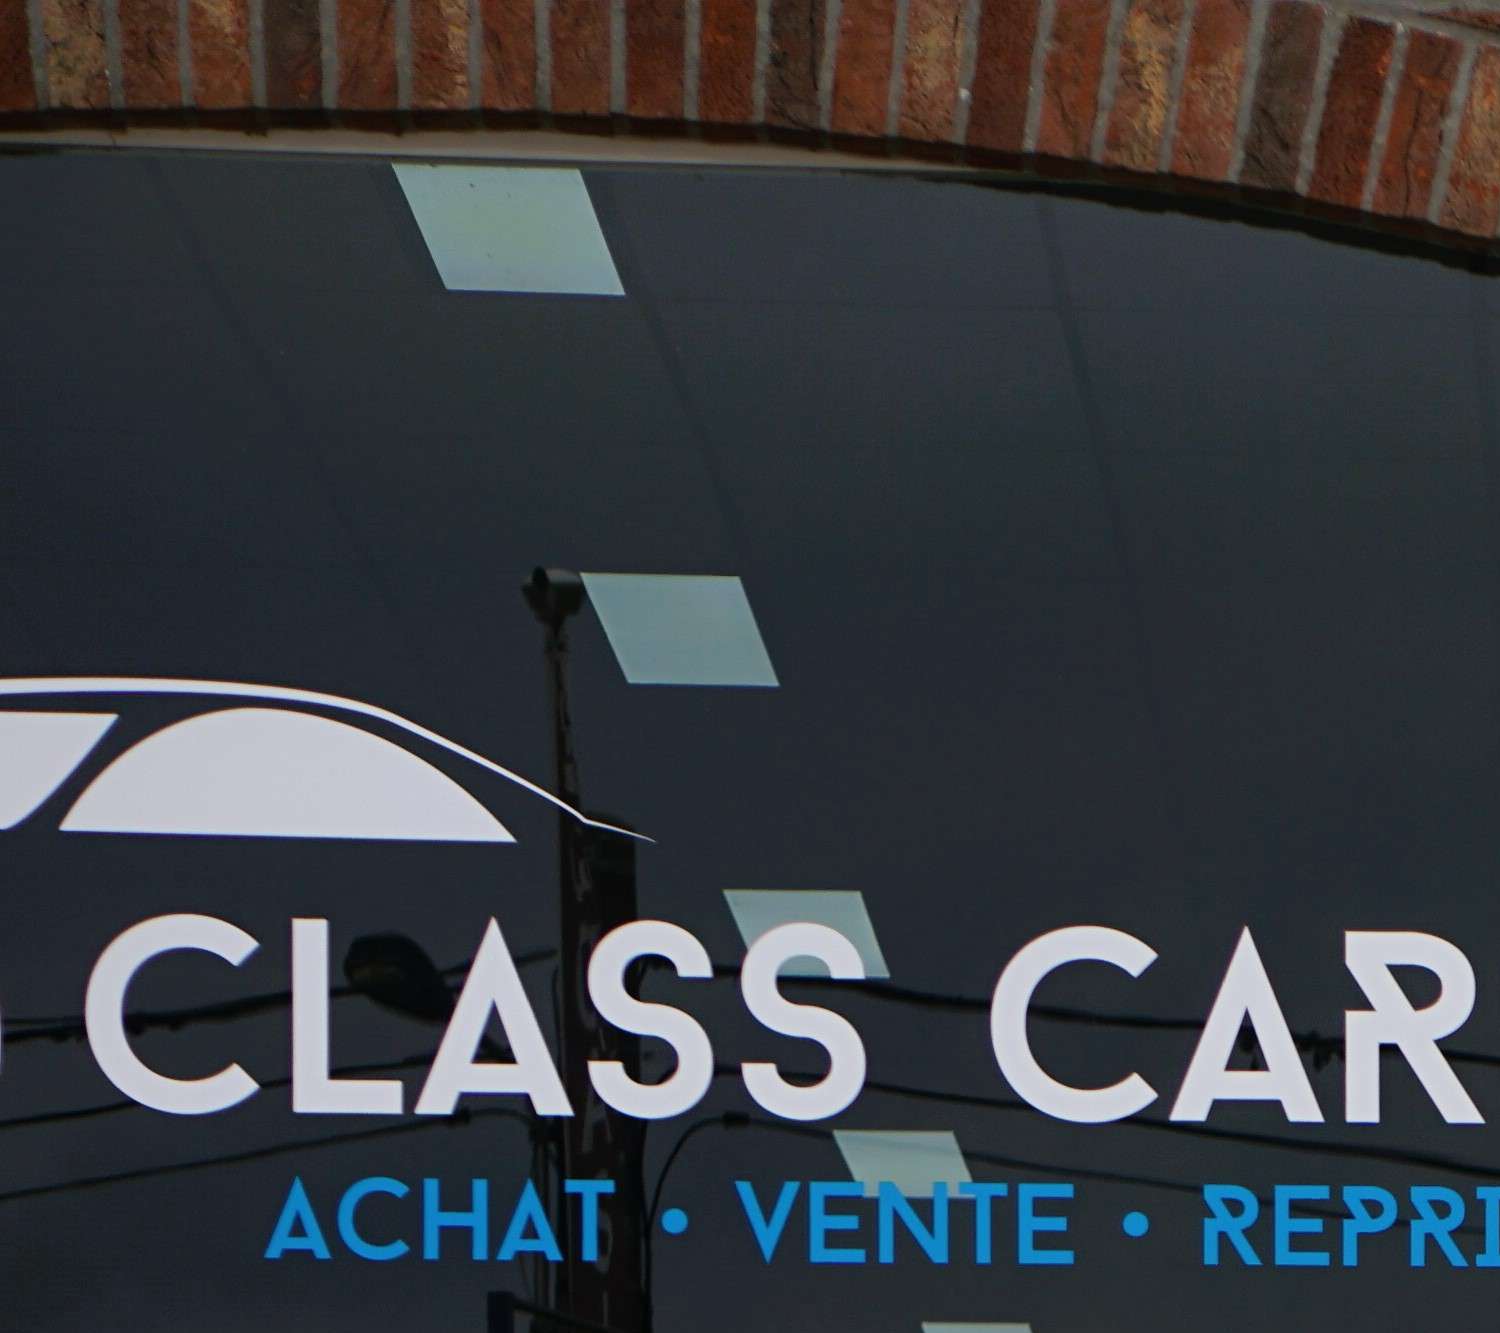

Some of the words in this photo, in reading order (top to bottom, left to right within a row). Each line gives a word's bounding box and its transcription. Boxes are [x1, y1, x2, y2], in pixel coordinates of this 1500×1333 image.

[85, 913, 866, 1120] CLASS
[263, 1177, 615, 1262] ACHAT
[734, 1180, 1075, 1265] VENTE
